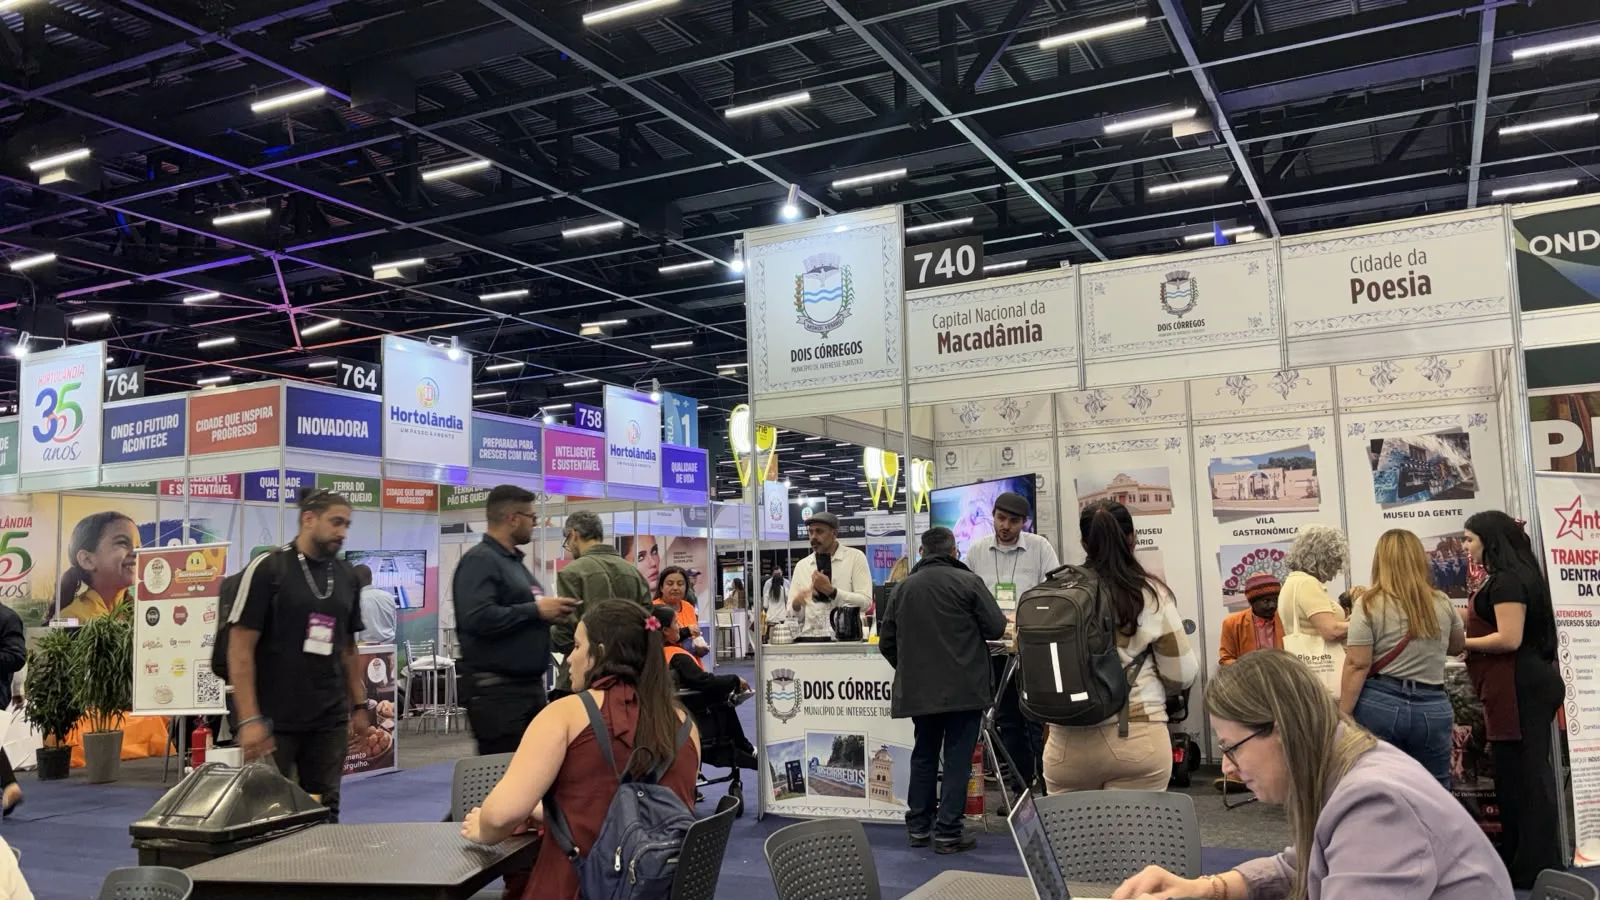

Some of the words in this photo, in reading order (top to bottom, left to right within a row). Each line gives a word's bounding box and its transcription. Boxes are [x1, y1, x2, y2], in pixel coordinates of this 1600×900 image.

[1529, 229, 1600, 256] OND
[914, 245, 976, 284] 740
[1350, 255, 1403, 274] Cidade
[1407, 248, 1427, 266] da
[1350, 270, 1432, 304] Poesia
[932, 311, 972, 331] Capital
[975, 303, 1027, 325] Nacional
[1030, 299, 1046, 316] da
[1157, 322, 1172, 332] DOIS
[936, 320, 1043, 355] Macadâmia
[790, 347, 812, 363] DOIS
[814, 340, 863, 359] CÓRREGOS
[820, 360, 841, 370] INTERESSE
[107, 371, 139, 397] 764
[342, 363, 378, 391] 764
[32, 382, 84, 444] 35
[196, 415, 223, 432] CIDADE
[225, 411, 240, 423] QUE
[241, 405, 274, 421] INSPIRA
[390, 405, 464, 431] Hortolândia
[579, 408, 602, 428] 758
[111, 424, 134, 440] ONDE
[136, 421, 141, 433] O
[143, 413, 179, 432] FUTURO
[211, 422, 257, 442] PROGRESSO
[297, 416, 369, 438] INOVADORA
[42, 441, 82, 461] anos
[122, 433, 168, 454] ACONTECE
[482, 437, 518, 449] PREPARADA
[518, 439, 534, 450] PARA
[555, 446, 596, 458] INTELIGENTE
[610, 443, 657, 461] Hortolândia
[479, 449, 507, 459] CRESCER
[508, 451, 521, 461] COM
[552, 460, 556, 470] E
[671, 462, 698, 473] QUALIDADE
[333, 481, 355, 491] TERRA
[355, 482, 365, 491] DO
[676, 473, 684, 483] DE
[684, 474, 695, 484] VIDA
[168, 484, 175, 495] E
[266, 488, 277, 499] DE
[447, 495, 459, 506] PÃO
[460, 494, 469, 503] DE
[1255, 517, 1275, 525] VILA
[1383, 511, 1414, 519] MUSEU
[1434, 508, 1463, 518] GENTE
[1232, 526, 1299, 537] GASTRONÔMICA
[1551, 548, 1600, 566] TRANSF
[1578, 583, 1594, 597] DA
[1556, 610, 1592, 618] ATENDEMOS
[804, 681, 834, 700] DOIS
[804, 705, 835, 717] MUNICÍPIO
[836, 706, 845, 716] DE
[846, 706, 878, 716] INTERESSE
